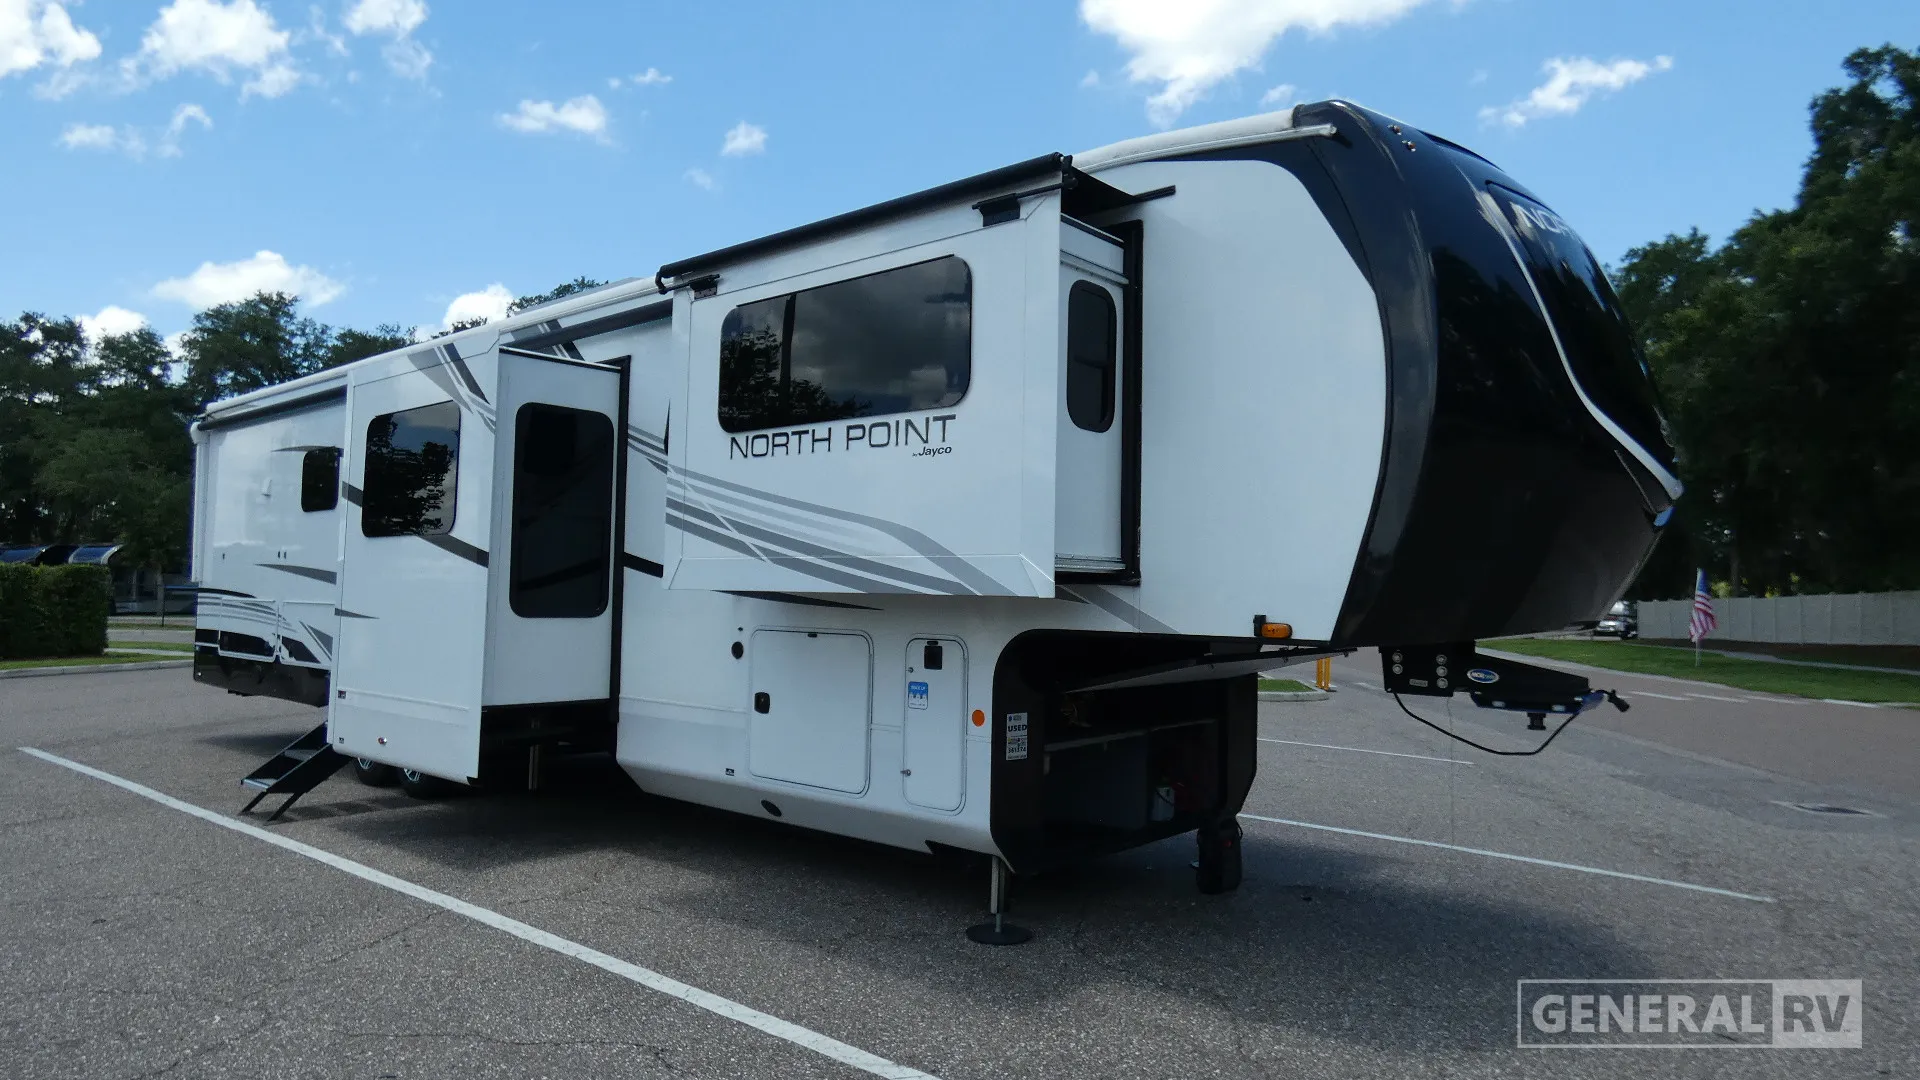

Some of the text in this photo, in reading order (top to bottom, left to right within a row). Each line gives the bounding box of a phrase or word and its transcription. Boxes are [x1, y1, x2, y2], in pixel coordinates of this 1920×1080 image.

[730, 414, 957, 460] NORTH POINT
[918, 446, 953, 458] Jayco
[1008, 724, 1028, 732] USED
